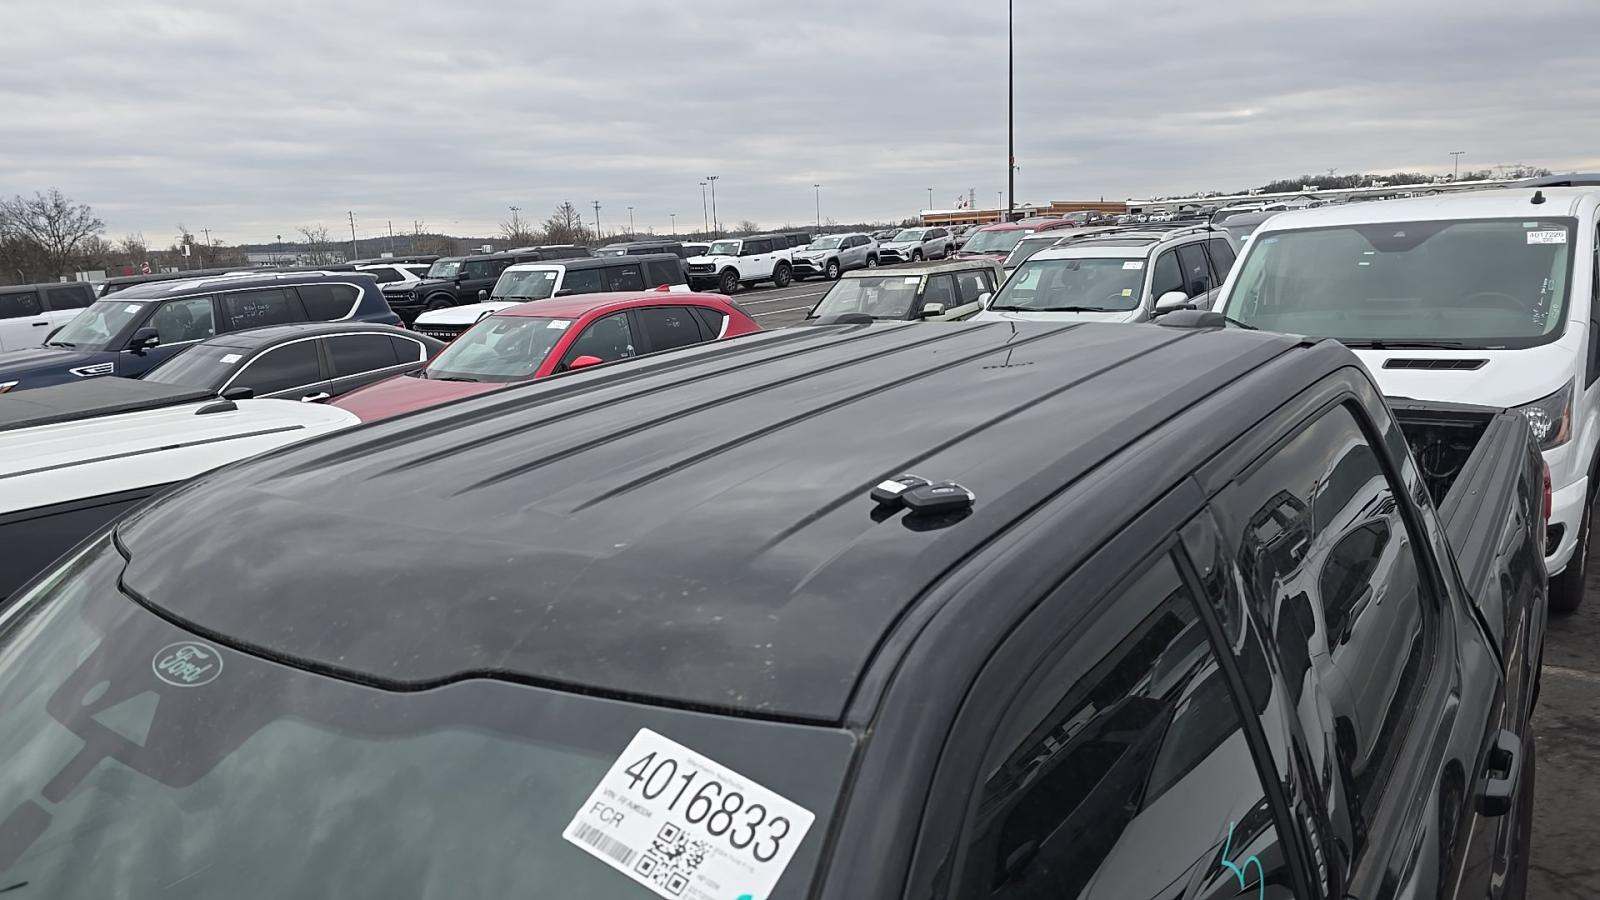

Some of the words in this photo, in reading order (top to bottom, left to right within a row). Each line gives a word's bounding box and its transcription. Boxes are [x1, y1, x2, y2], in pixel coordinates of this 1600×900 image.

[159, 646, 213, 682] Ford
[589, 801, 625, 828] FCR
[624, 752, 791, 863] 4016833
